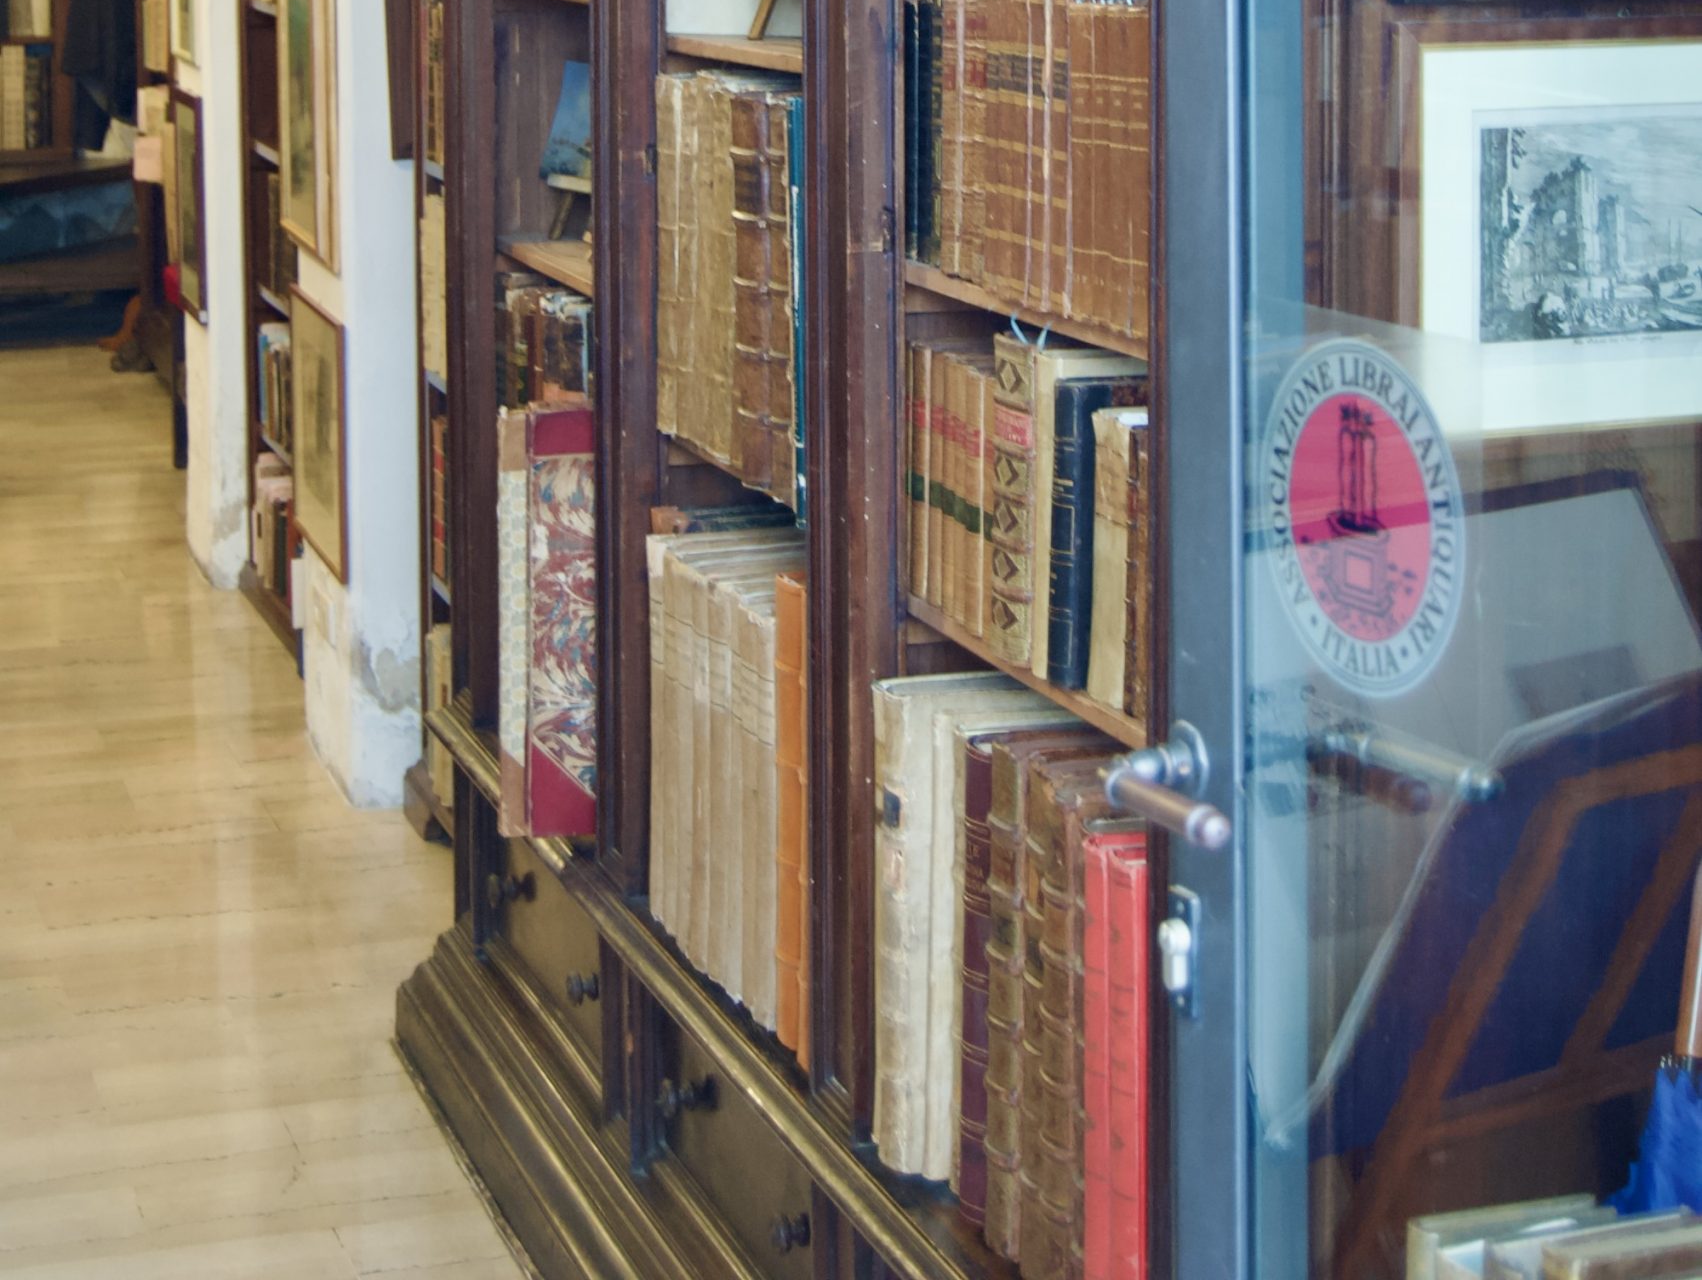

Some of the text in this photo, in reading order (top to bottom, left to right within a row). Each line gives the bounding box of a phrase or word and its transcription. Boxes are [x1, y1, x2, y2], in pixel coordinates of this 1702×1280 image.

[1270, 356, 1456, 656] ASSOCIAZIONE LIBRAI ANTIQUARI
[1321, 623, 1402, 678] ITALIA
